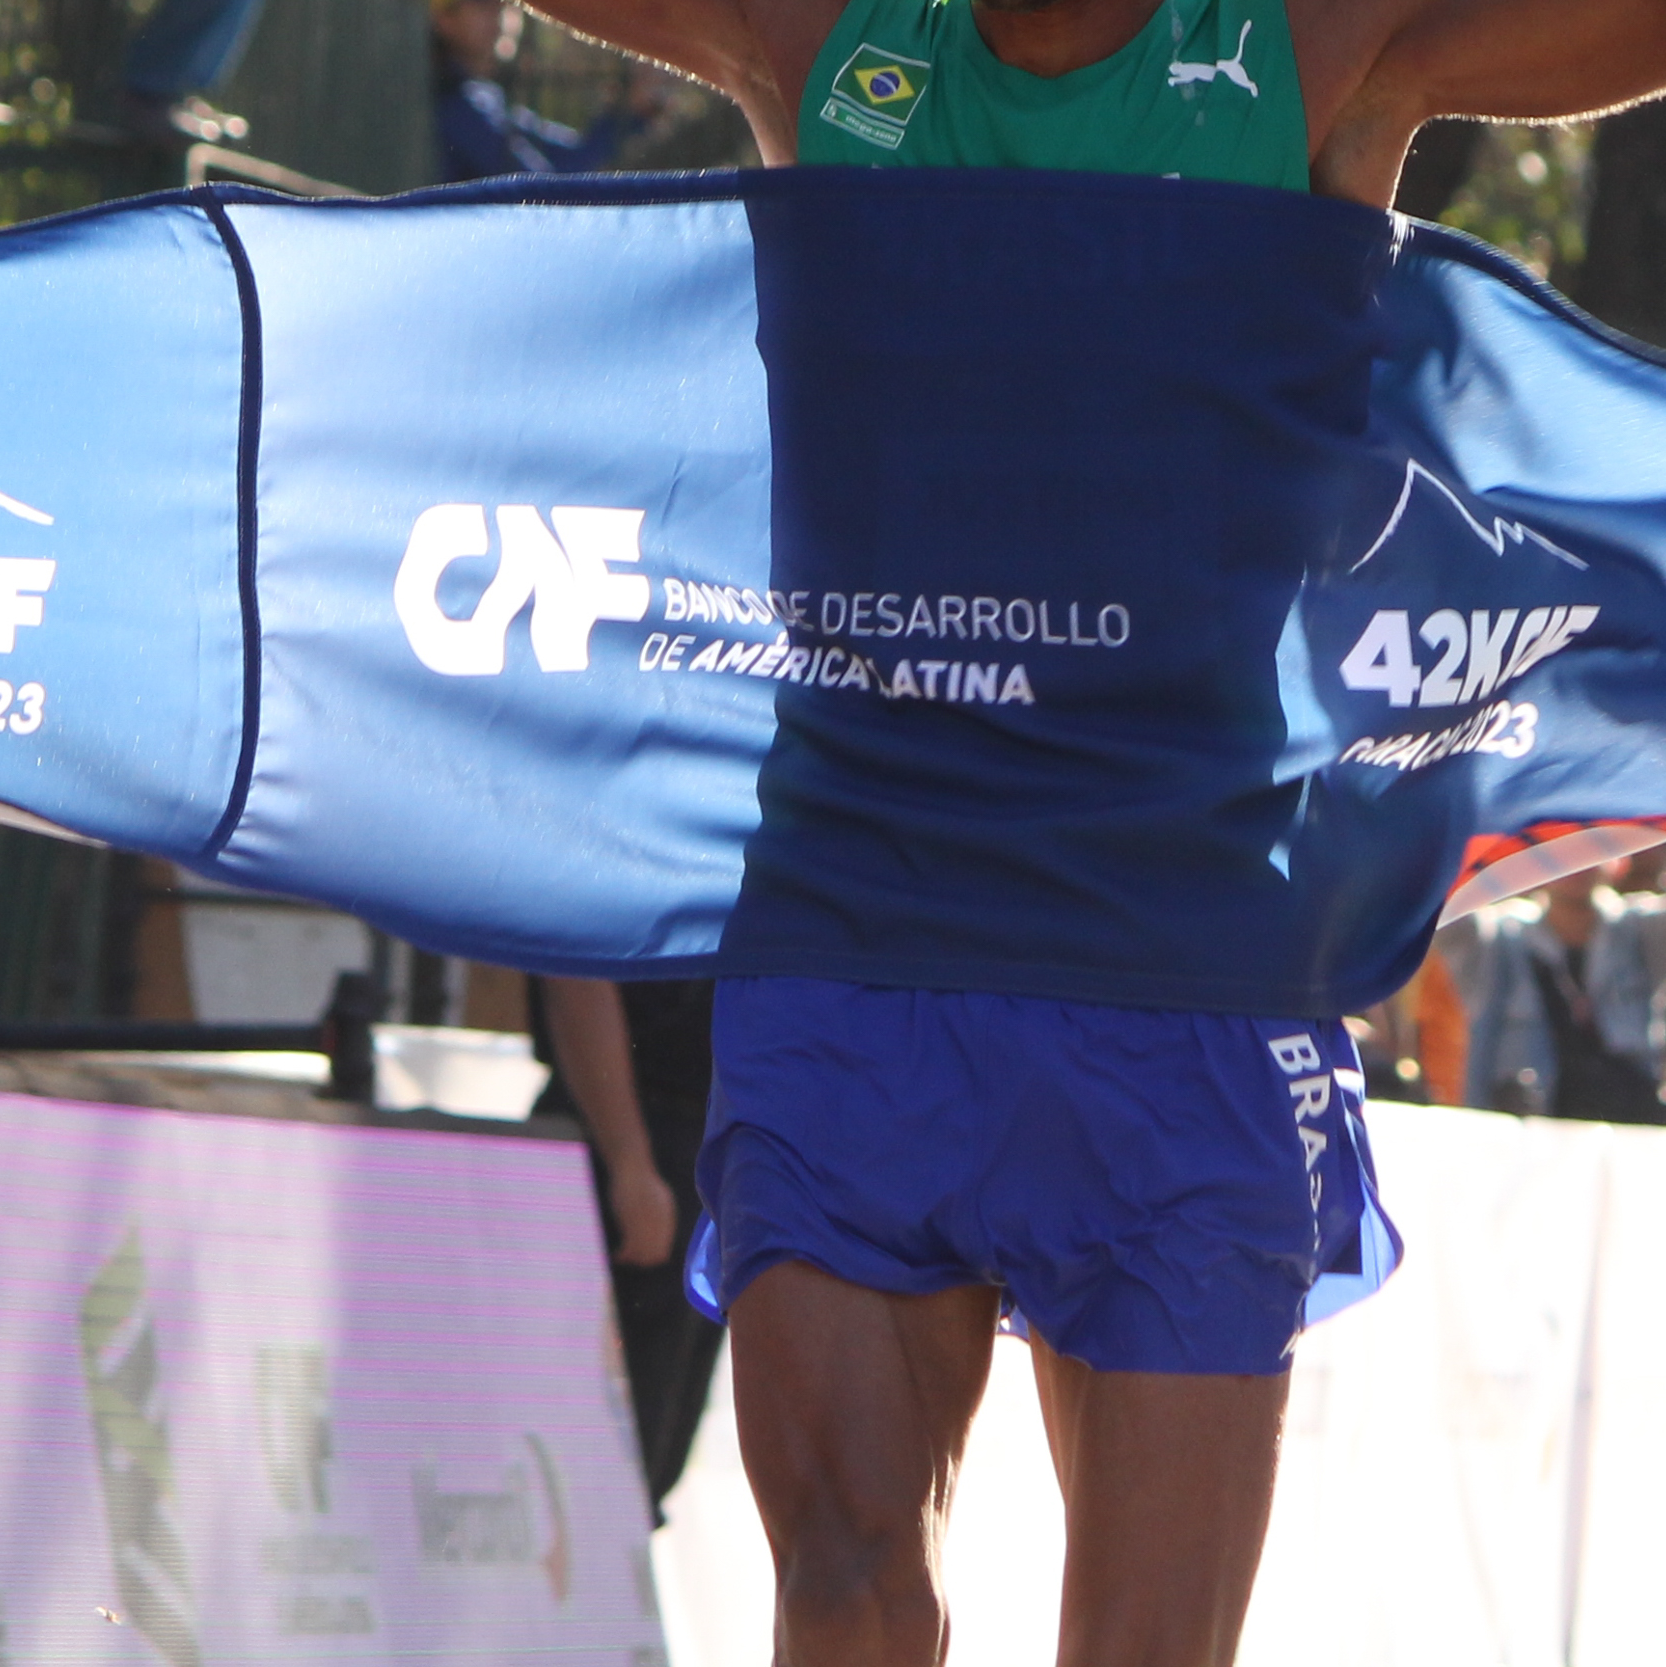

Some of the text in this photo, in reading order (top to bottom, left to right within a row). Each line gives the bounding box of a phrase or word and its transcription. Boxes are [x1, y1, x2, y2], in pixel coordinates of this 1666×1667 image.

[393, 503, 650, 676] CAF
[663, 577, 1131, 648] BANCO DE DESARROLLO
[639, 631, 1036, 706] DE AMÉRICA LATINA
